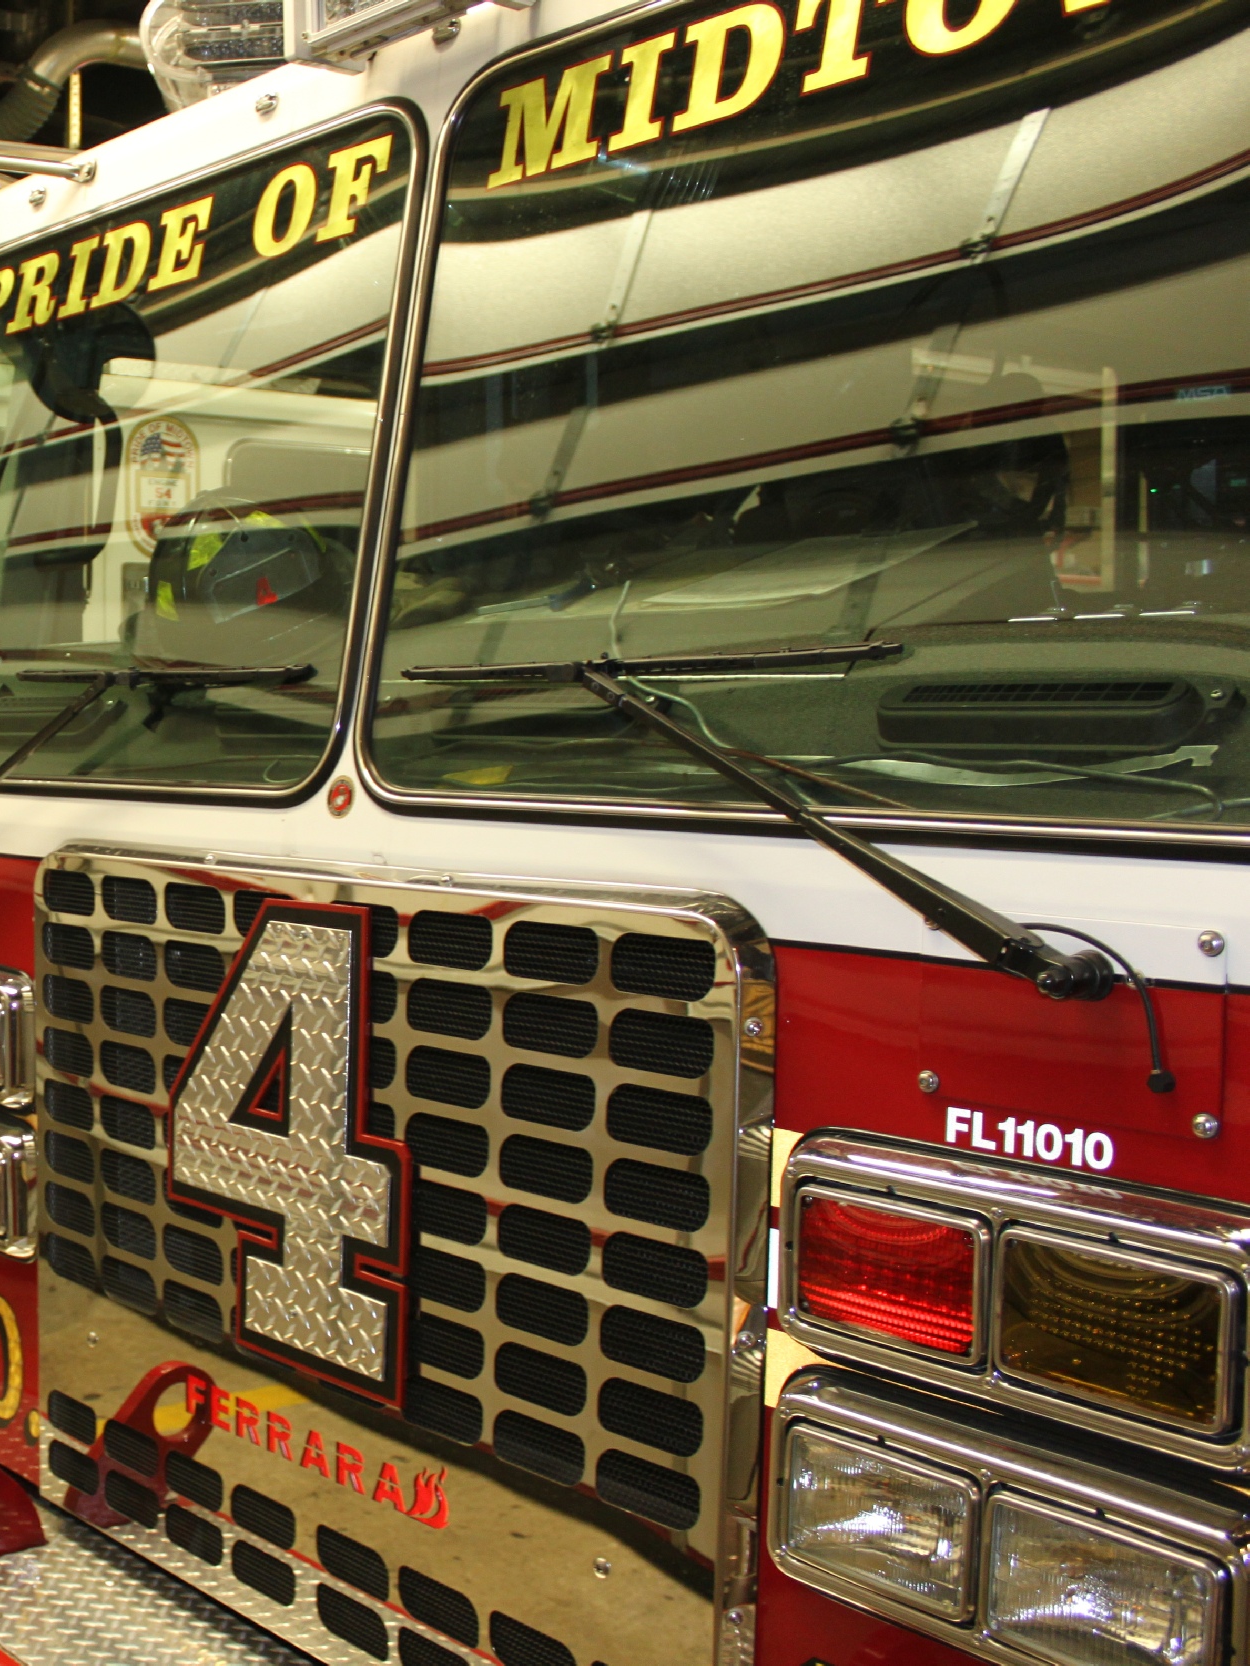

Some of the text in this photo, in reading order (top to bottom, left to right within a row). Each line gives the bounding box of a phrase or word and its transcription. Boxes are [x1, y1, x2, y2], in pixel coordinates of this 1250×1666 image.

[251, 132, 394, 260] OF
[170, 904, 406, 1401] 4
[944, 1106, 1114, 1170] FL11010
[185, 1374, 409, 1514] FERRARA
